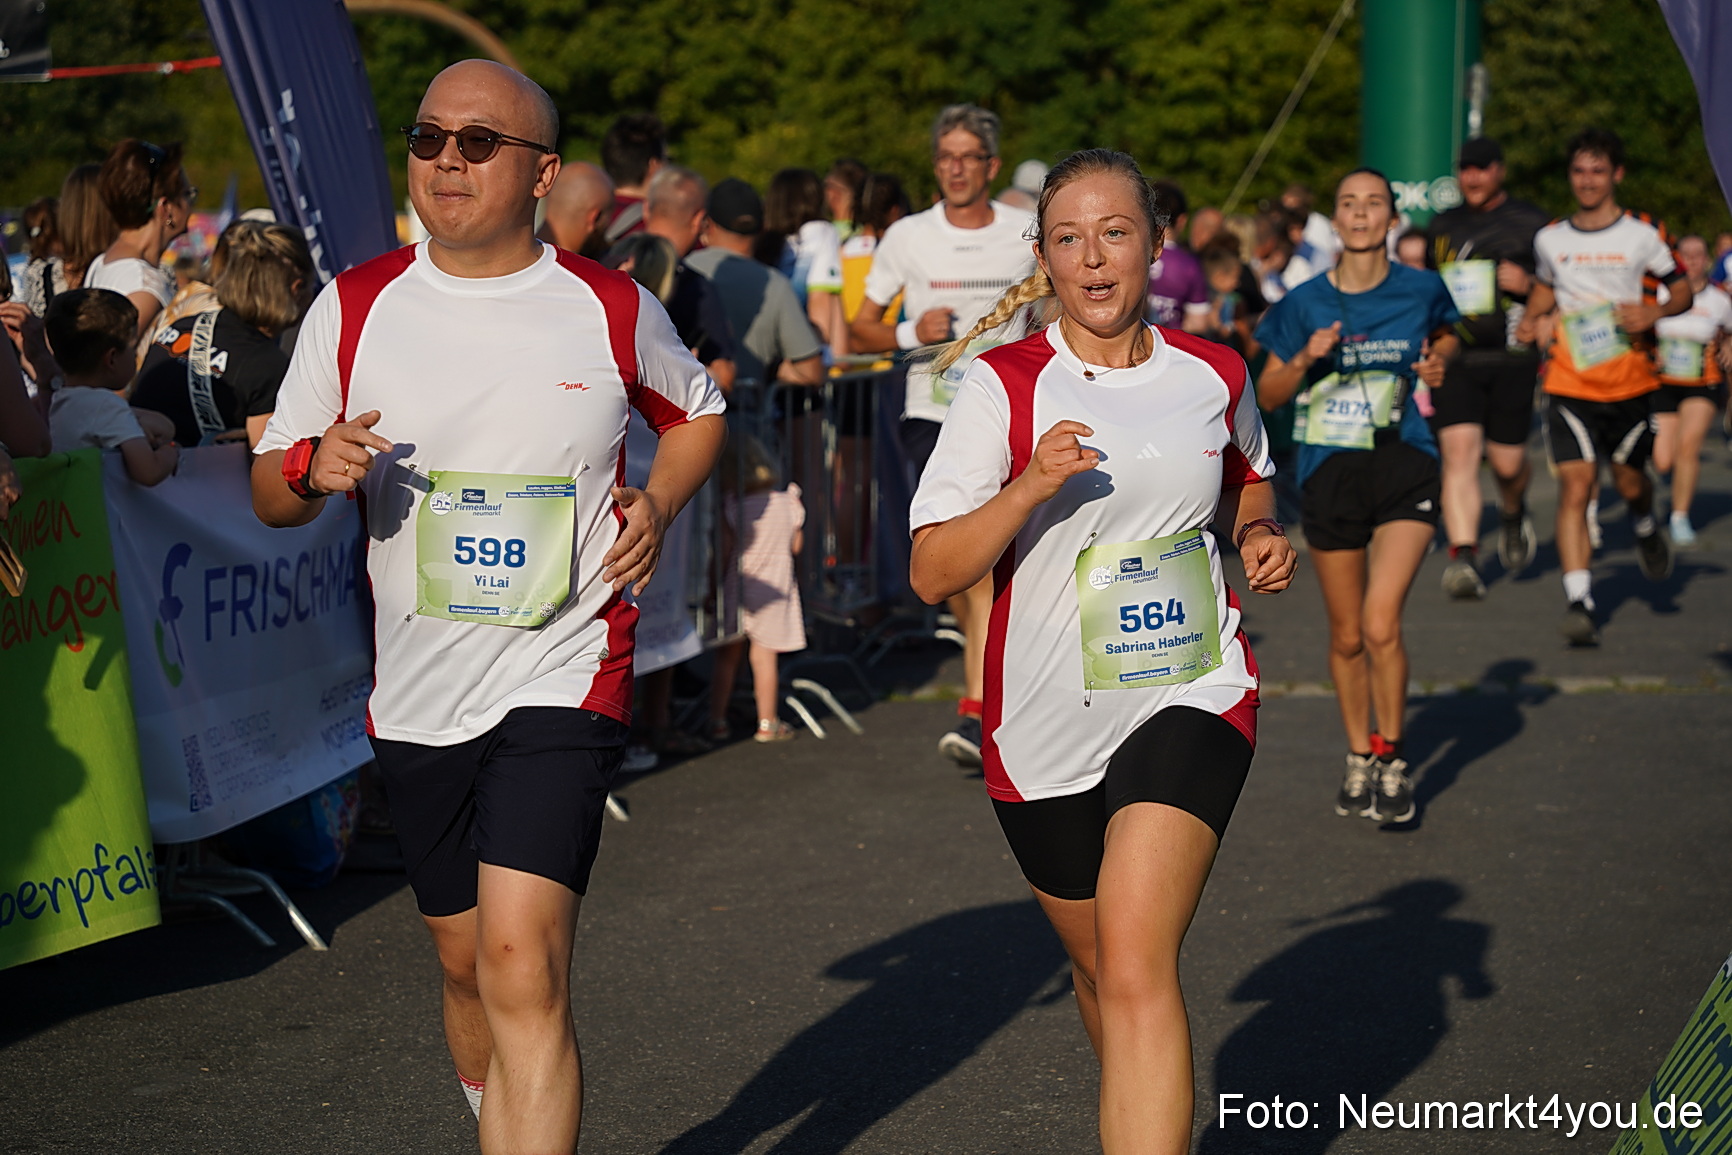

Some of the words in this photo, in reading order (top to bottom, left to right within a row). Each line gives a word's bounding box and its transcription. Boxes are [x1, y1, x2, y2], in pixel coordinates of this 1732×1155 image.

[454, 502, 502, 512] Firmenlauf
[454, 536, 526, 568] 598
[474, 574, 487, 587] Yi
[490, 576, 510, 588] Lai
[1114, 566, 1159, 583] Firmenlauf
[1132, 574, 1159, 585] neumarkt
[1119, 597, 1186, 633] 564
[1105, 641, 1156, 655] Sabrina
[1158, 631, 1204, 649] Haberler
